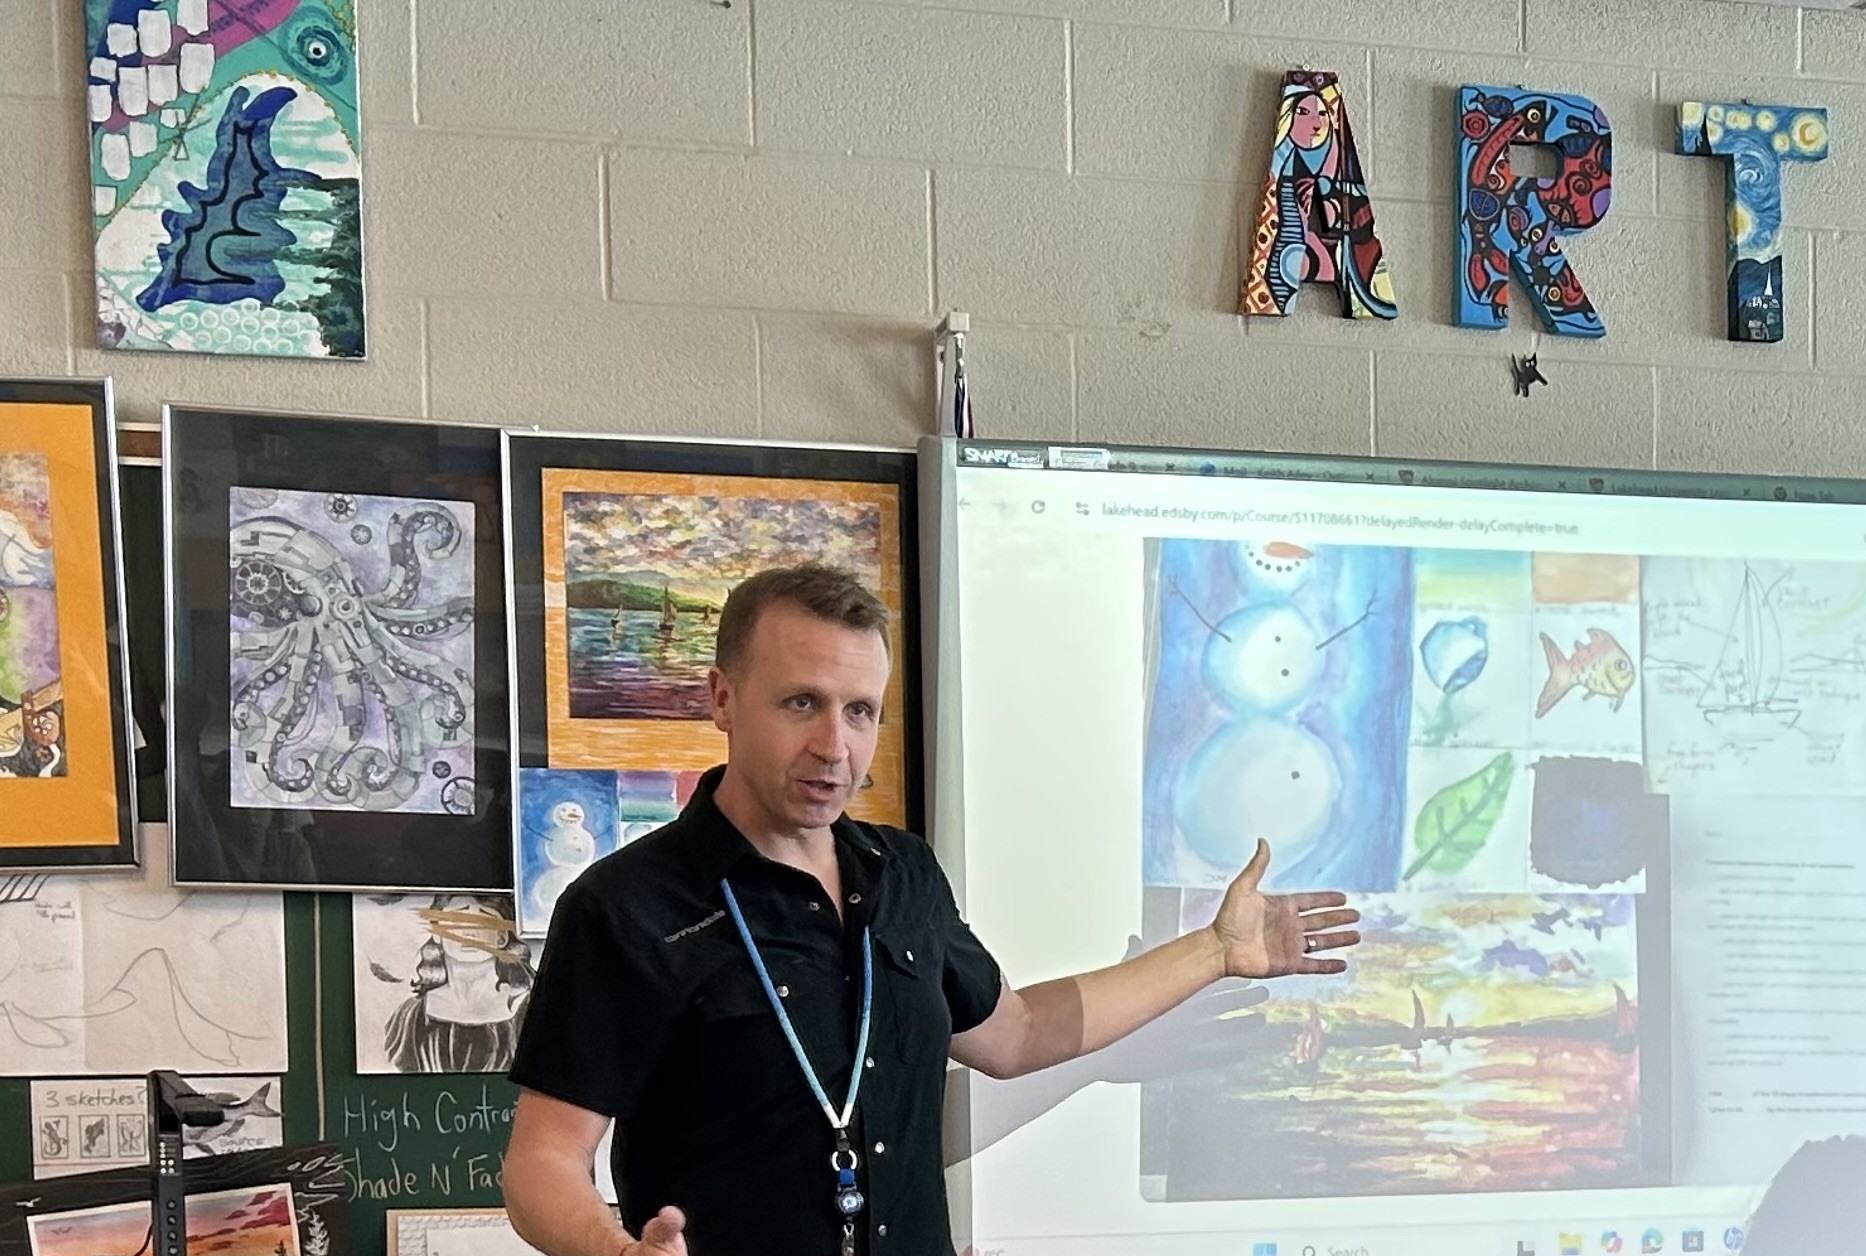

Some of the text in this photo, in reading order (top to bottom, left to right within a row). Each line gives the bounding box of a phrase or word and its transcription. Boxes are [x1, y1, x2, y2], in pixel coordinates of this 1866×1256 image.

[1238, 69, 1828, 342] ART
[46, 1089, 60, 1108] 3
[344, 1091, 421, 1152] High
